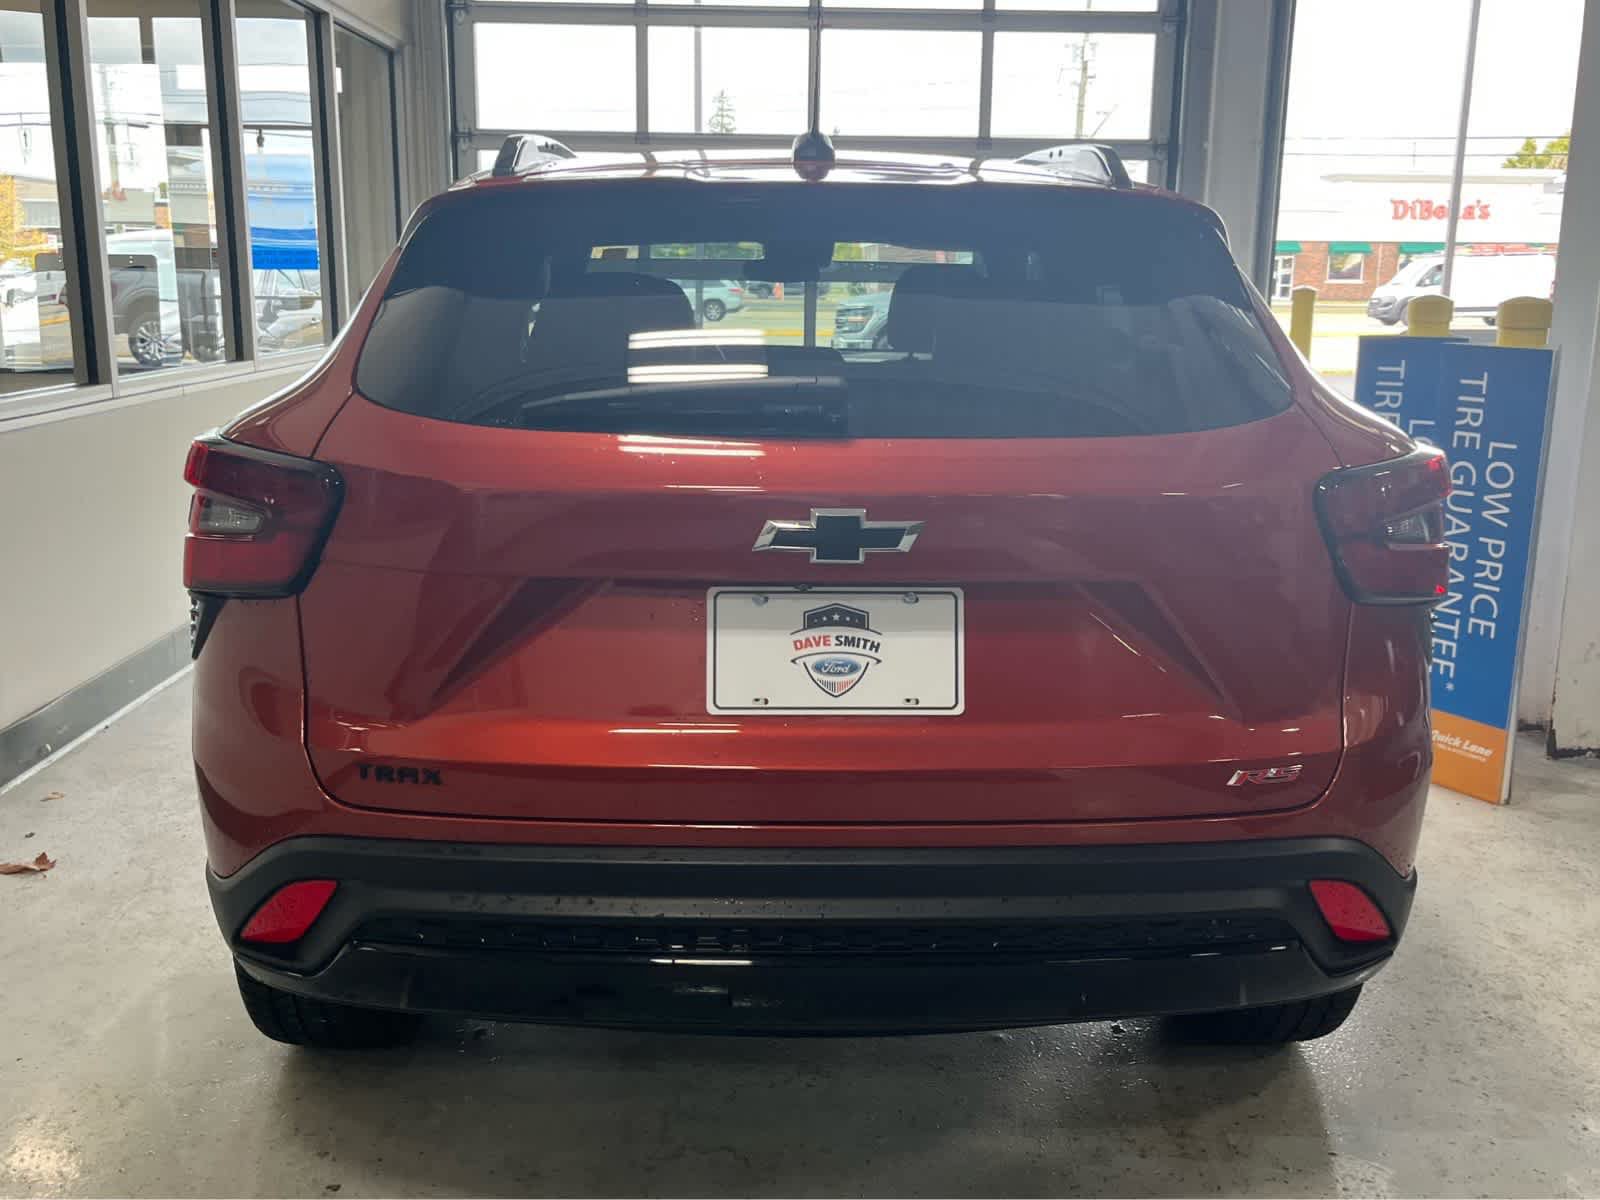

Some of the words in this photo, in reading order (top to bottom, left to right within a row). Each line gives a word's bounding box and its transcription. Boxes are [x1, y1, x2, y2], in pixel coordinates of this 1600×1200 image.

[1390, 198, 1491, 220] DiBea's
[1452, 371, 1488, 450] TIRE
[1481, 441, 1518, 528] LOW
[1467, 537, 1506, 640] PRICE
[793, 635, 832, 651] DAVE
[834, 635, 881, 653] SMITH
[820, 660, 852, 674] Ford
[1461, 740, 1494, 757] Lane
[357, 763, 443, 785] TRAX
